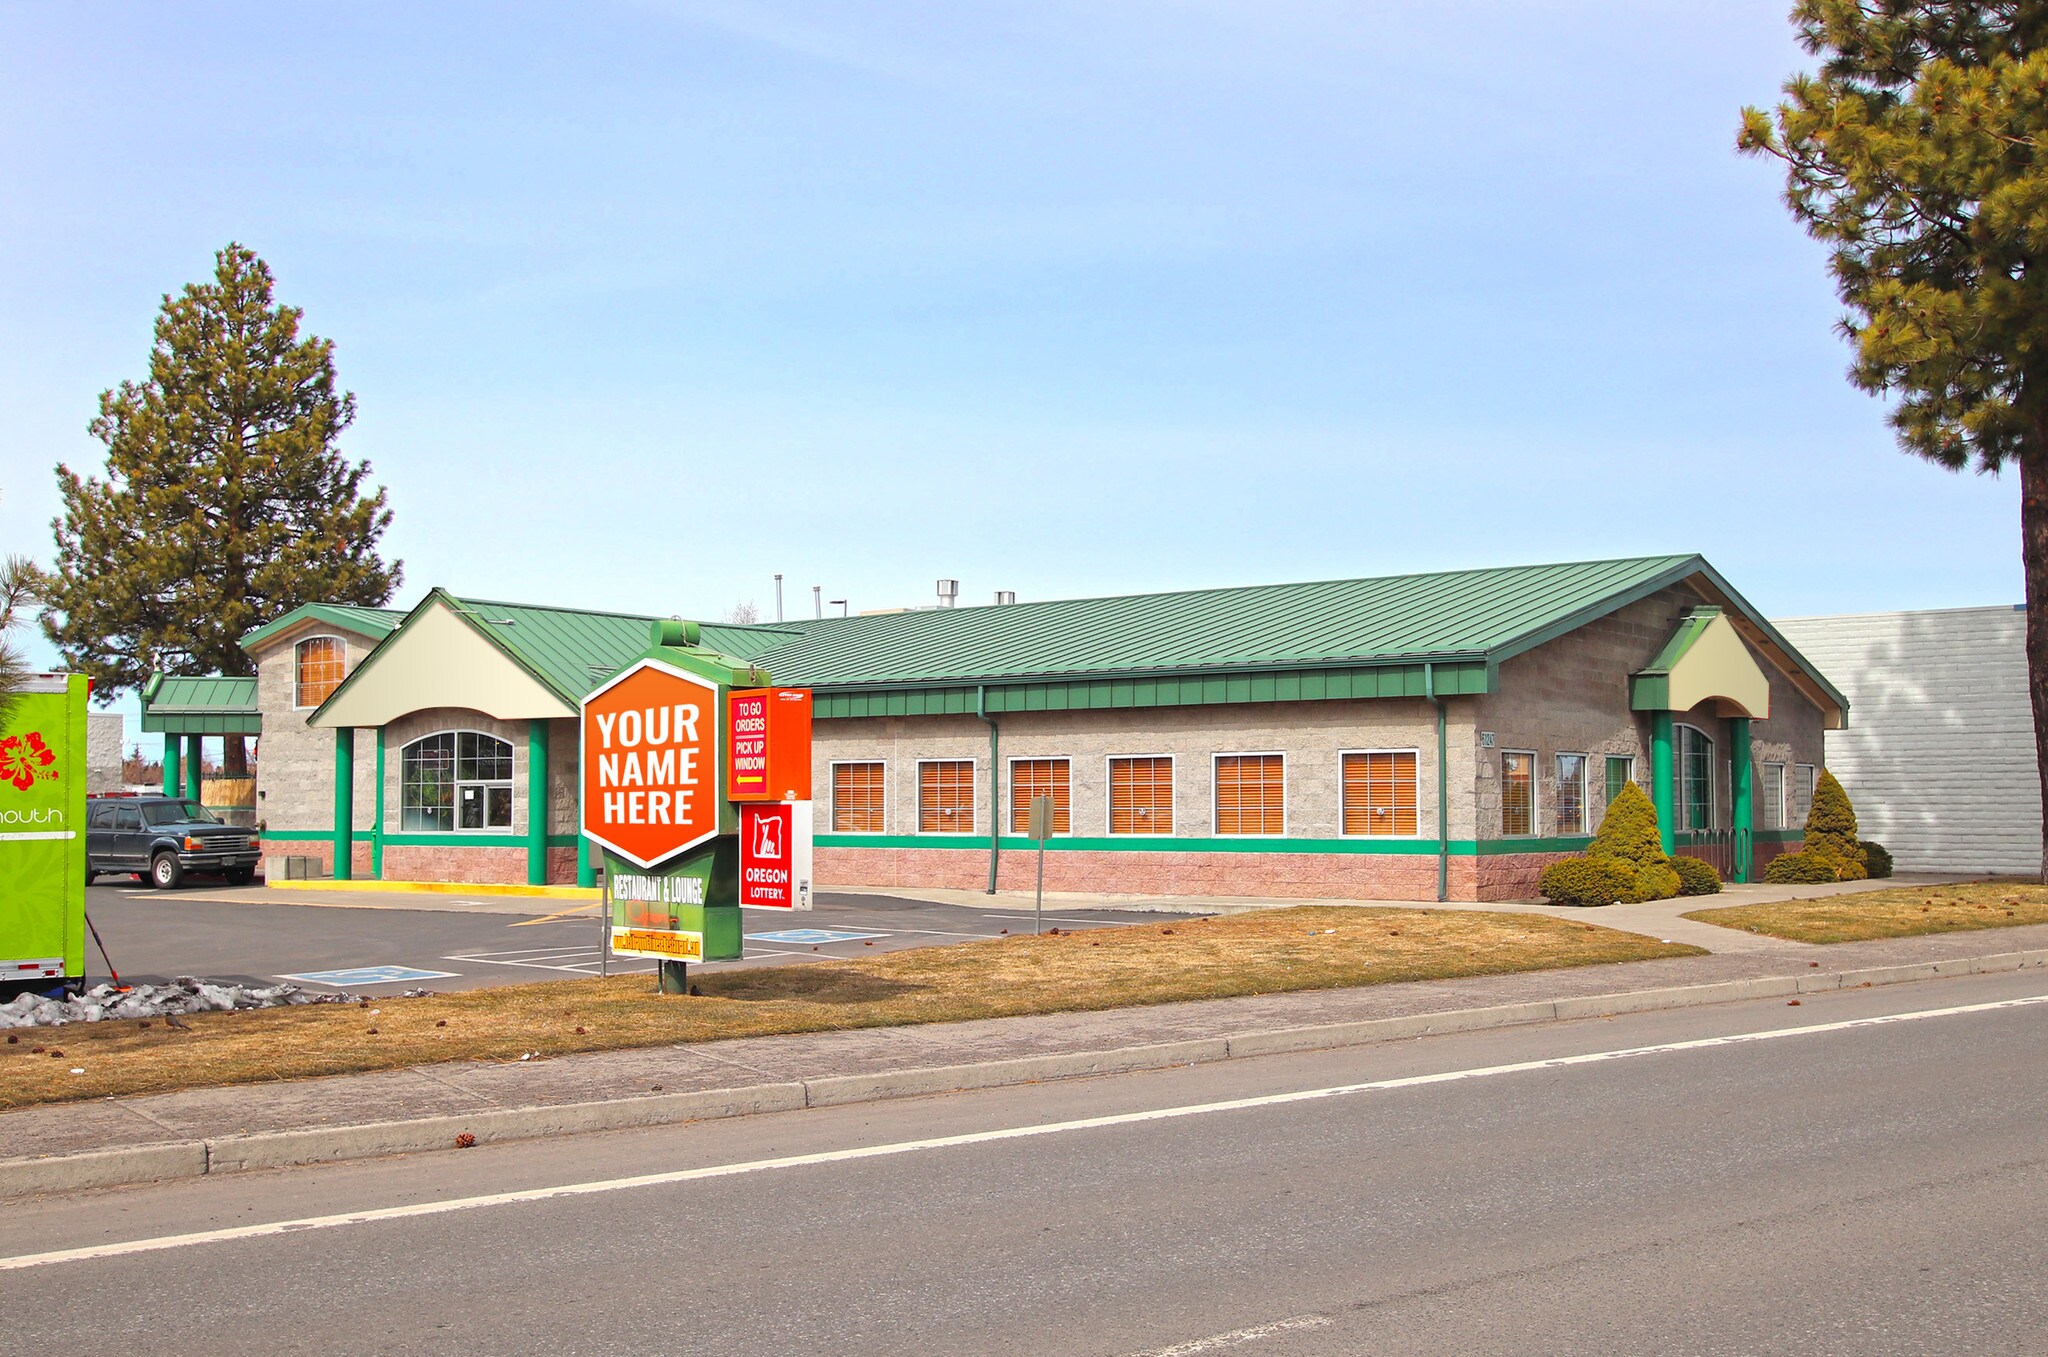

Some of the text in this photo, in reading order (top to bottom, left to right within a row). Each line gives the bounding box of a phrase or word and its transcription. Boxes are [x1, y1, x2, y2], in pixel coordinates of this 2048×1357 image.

[739, 701, 762, 717] TO GO
[595, 703, 700, 749] YOUR
[735, 717, 765, 733] ORDERS
[736, 740, 764, 755] PICK UP
[599, 747, 699, 788] NAME
[734, 756, 766, 770] WINDOW
[603, 790, 694, 825] HERE
[746, 867, 788, 884] OREGON
[613, 874, 703, 905] RESTAURANT & LOUNGE
